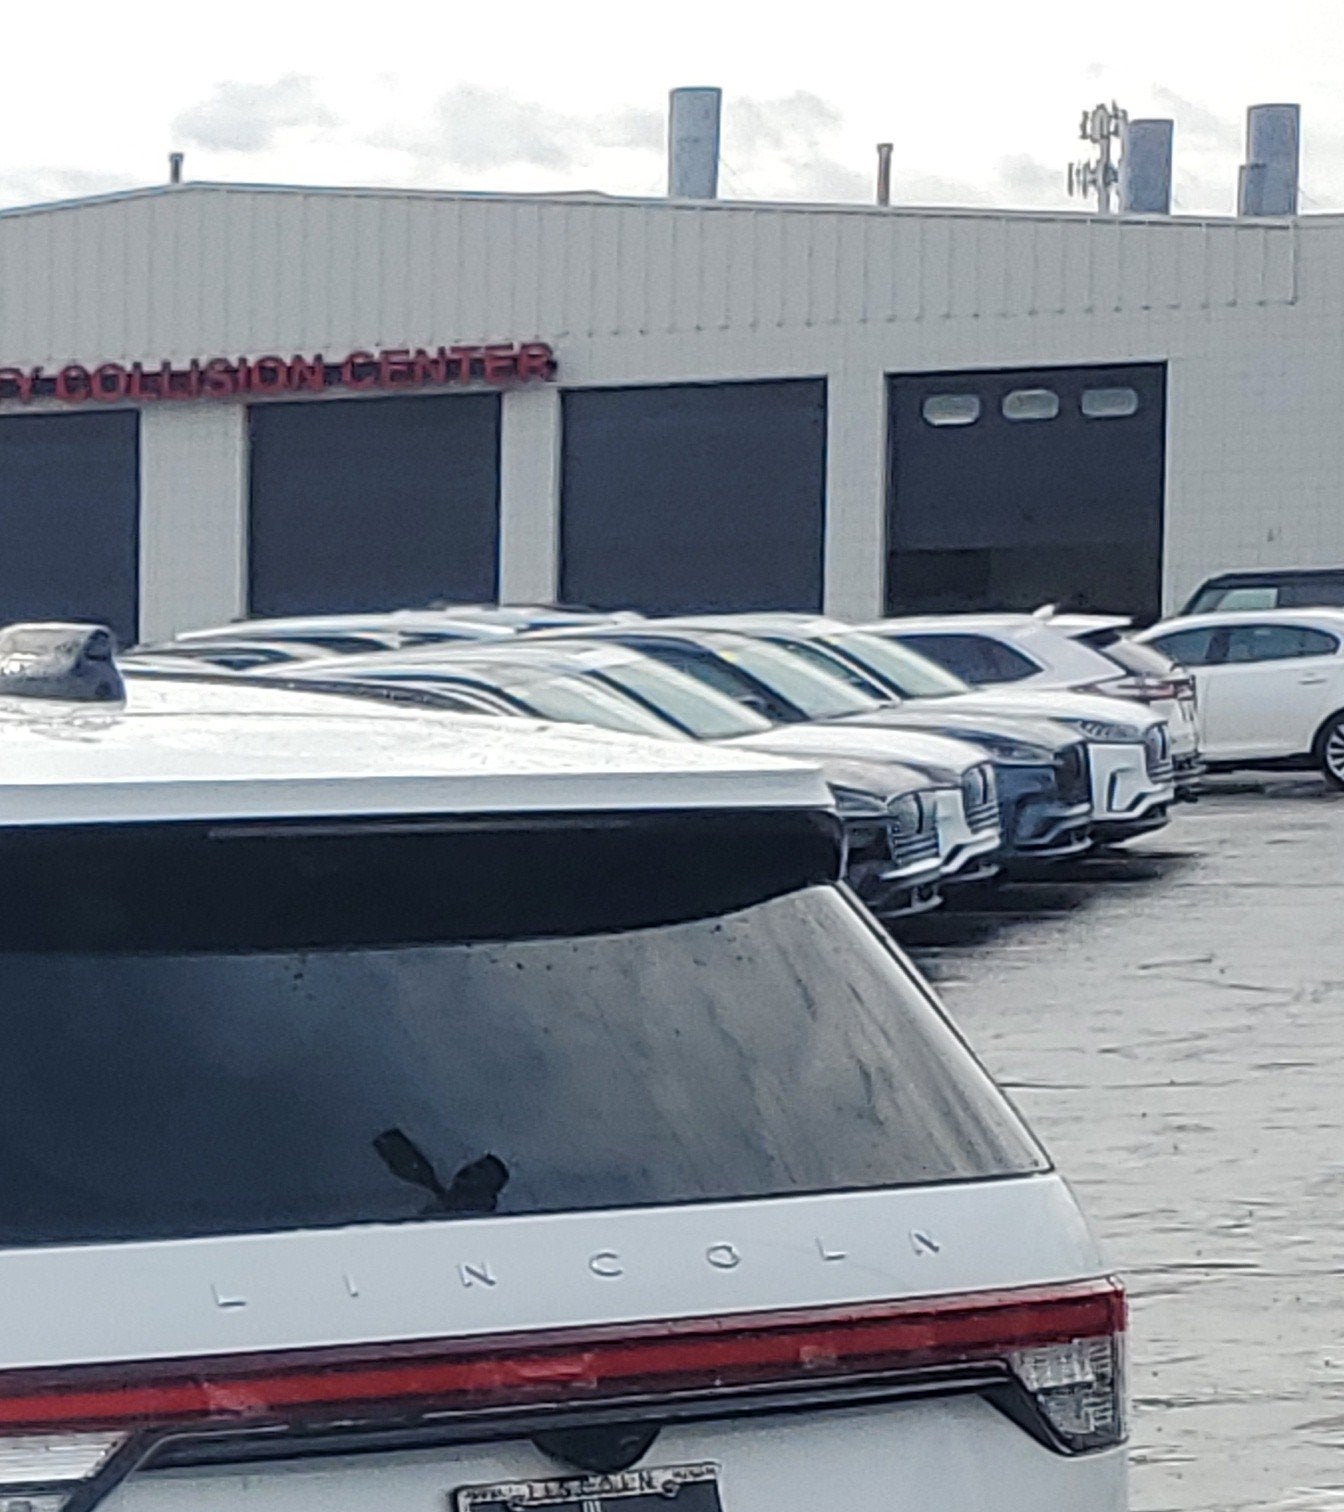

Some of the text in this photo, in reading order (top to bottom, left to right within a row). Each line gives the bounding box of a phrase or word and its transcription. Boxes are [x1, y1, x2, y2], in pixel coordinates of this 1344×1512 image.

[56, 354, 326, 404] COLLISION
[342, 341, 558, 391] CENTER
[212, 1229, 940, 1308] LINCOLN
